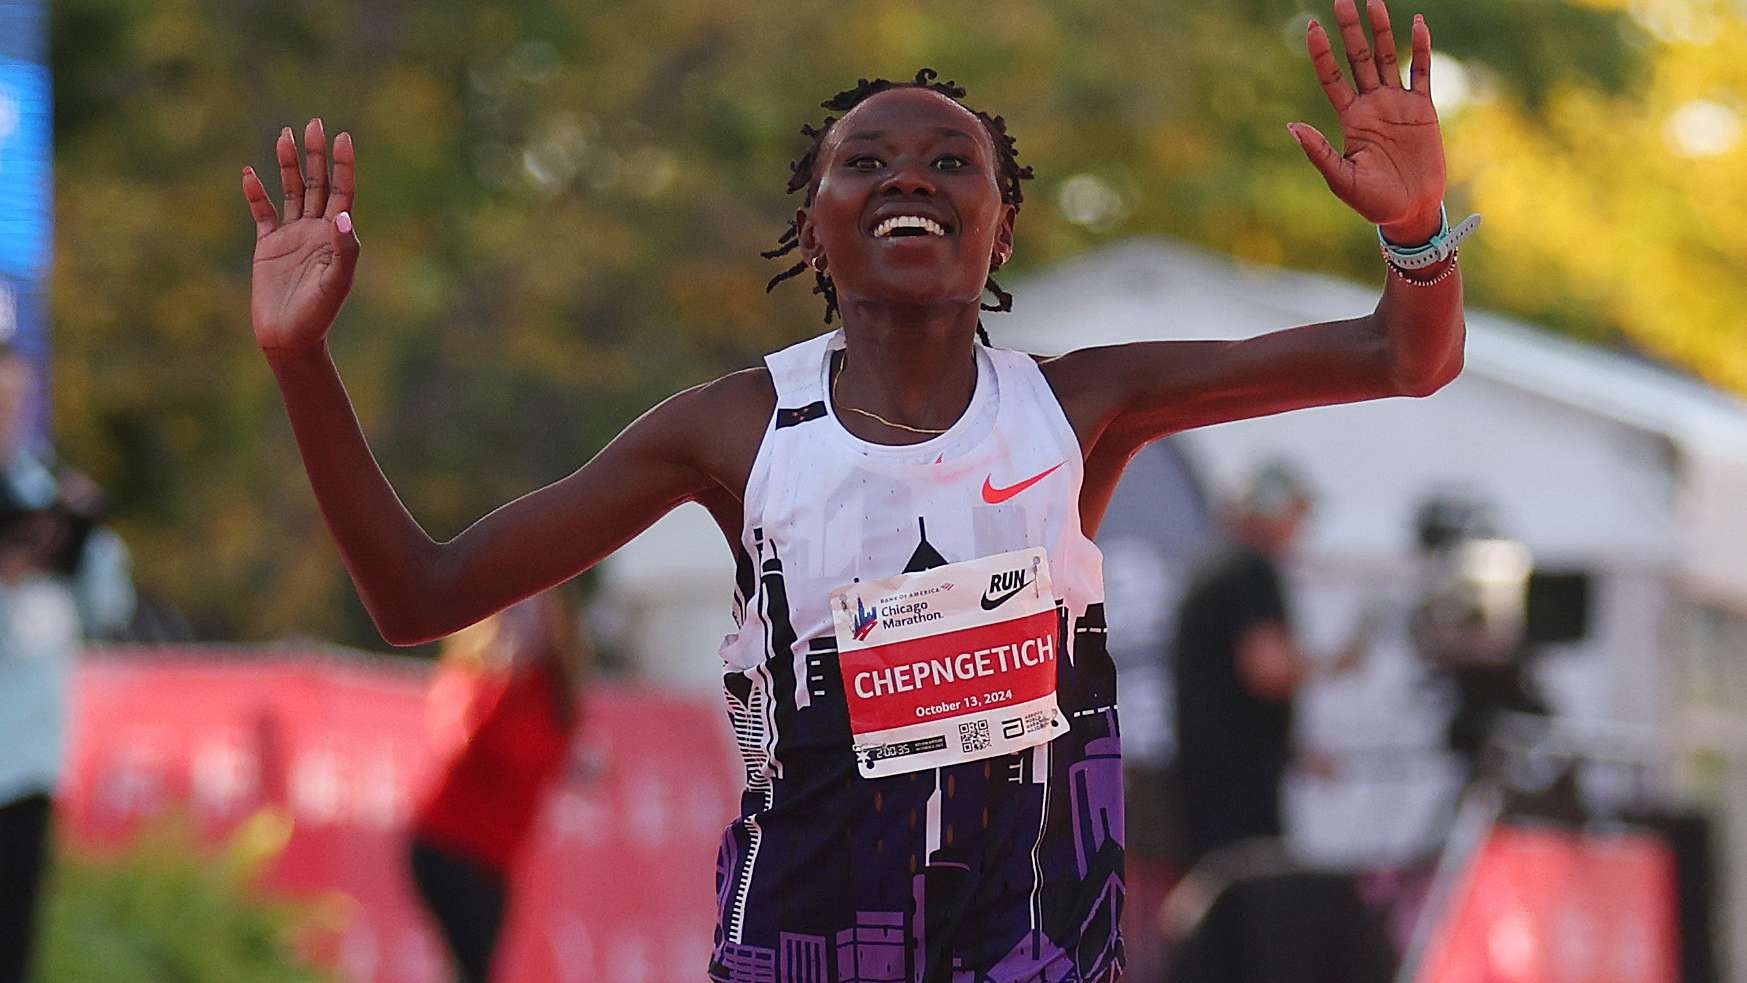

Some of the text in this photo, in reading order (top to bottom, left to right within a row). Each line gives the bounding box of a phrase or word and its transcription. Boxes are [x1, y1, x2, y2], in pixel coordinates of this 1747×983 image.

[989, 568, 1026, 594] RUN
[908, 587, 940, 599] AMERICA
[881, 601, 928, 617] Chicago
[882, 611, 942, 630] Marathon
[854, 634, 1055, 699] CHEPNGETICH
[915, 689, 1013, 718] October 13, 2024
